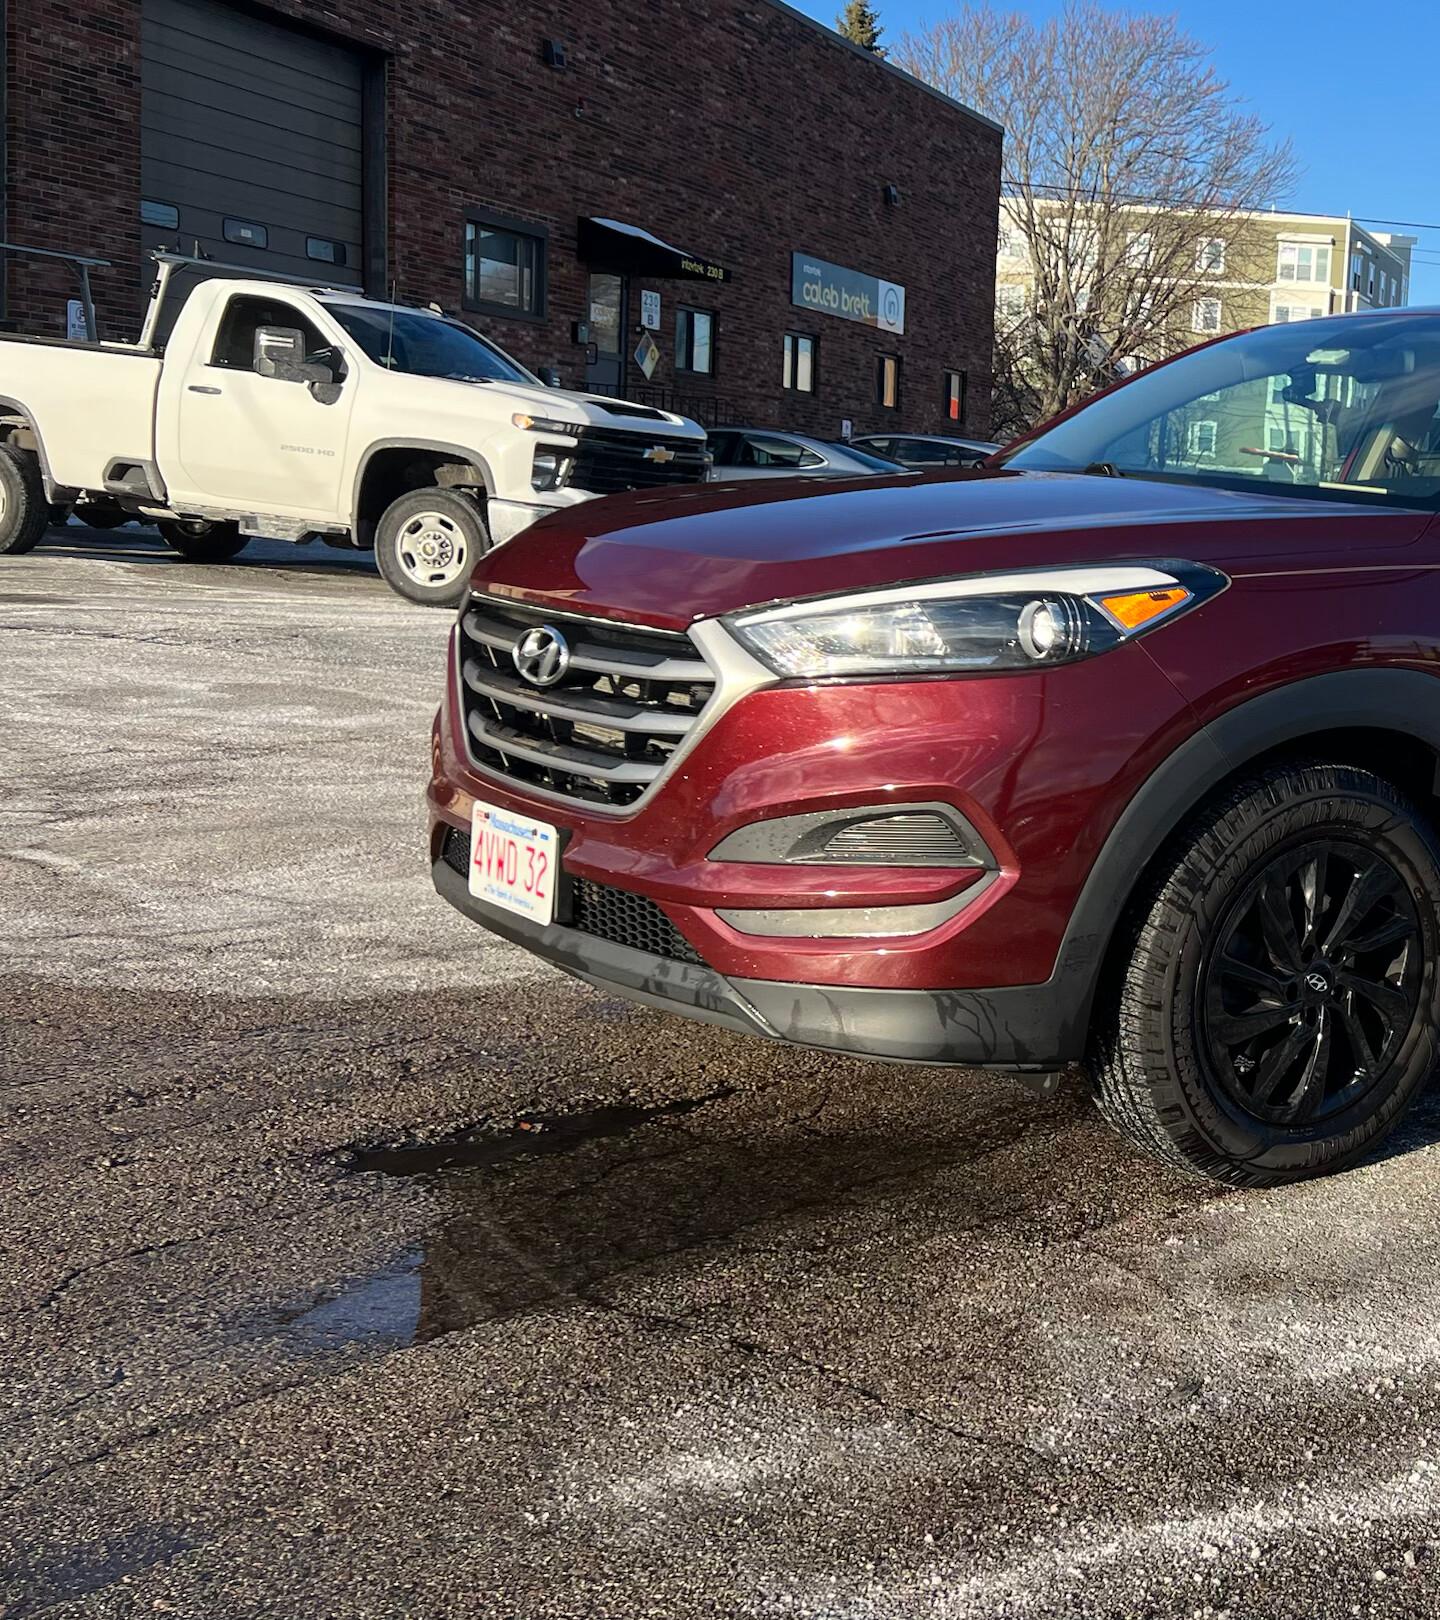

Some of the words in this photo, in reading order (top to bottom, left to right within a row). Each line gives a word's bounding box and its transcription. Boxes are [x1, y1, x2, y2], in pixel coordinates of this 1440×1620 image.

[803, 279, 839, 308] caleb
[841, 287, 871, 318] brett
[280, 444, 315, 455] 2500
[317, 449, 335, 457] HD
[474, 830, 518, 885] 4VWD
[524, 847, 548, 899] 32
